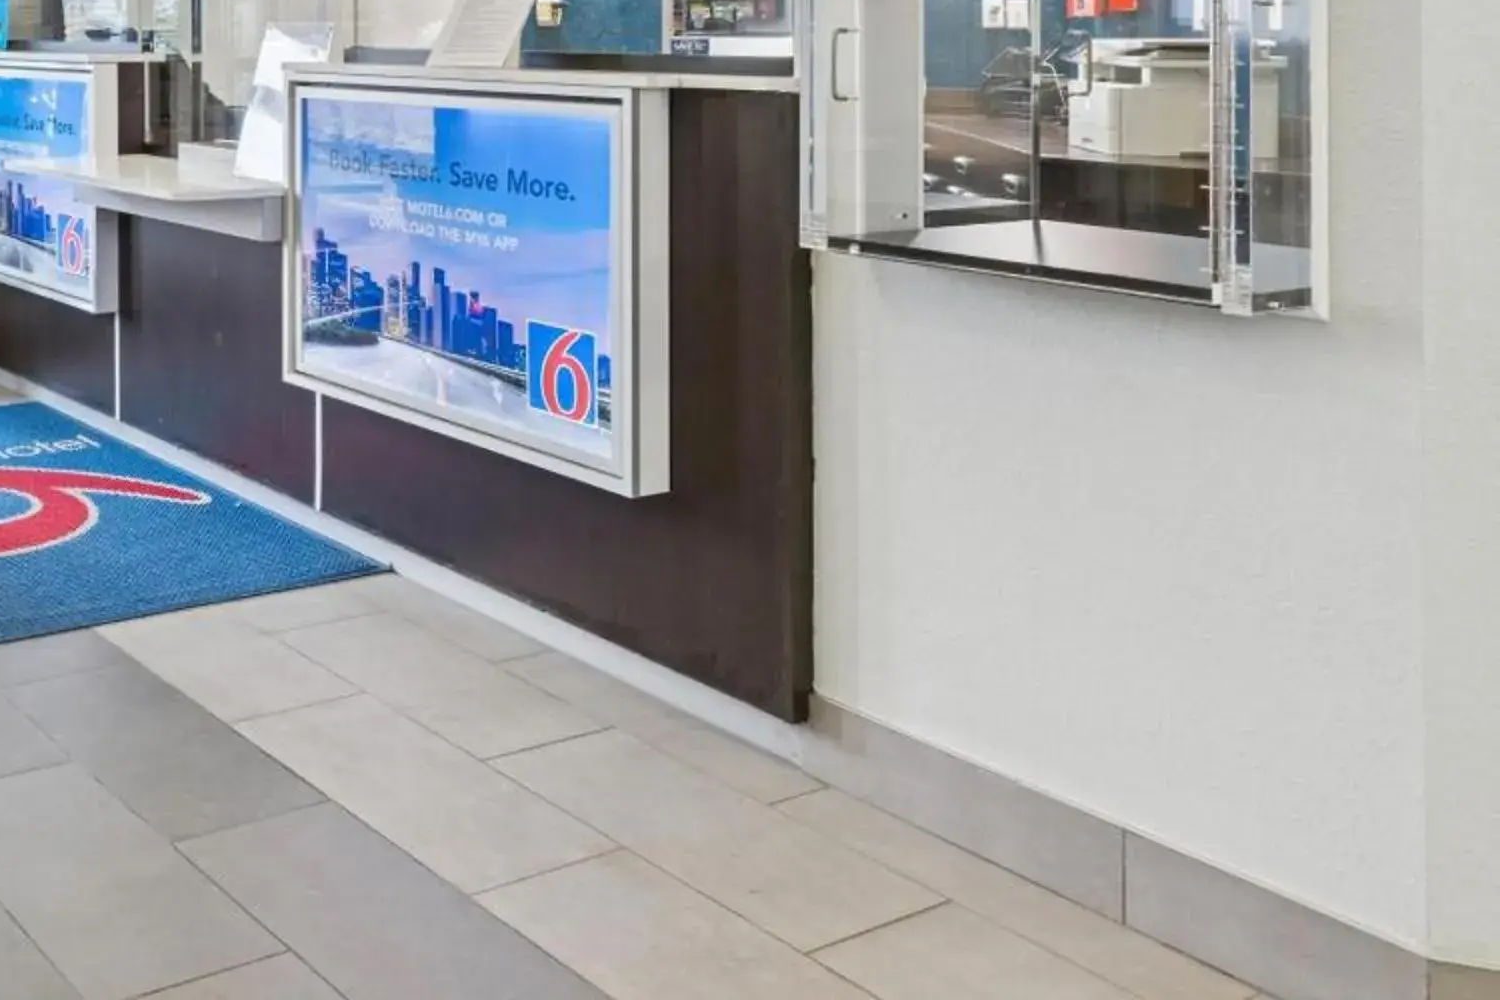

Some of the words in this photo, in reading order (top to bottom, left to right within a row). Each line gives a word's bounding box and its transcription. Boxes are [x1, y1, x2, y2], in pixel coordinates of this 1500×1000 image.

[329, 149, 373, 176] Book
[380, 153, 442, 184] Faster.
[448, 161, 498, 192] Save
[507, 167, 577, 201] More.
[438, 225, 461, 242] THE
[541, 331, 591, 423] 6
